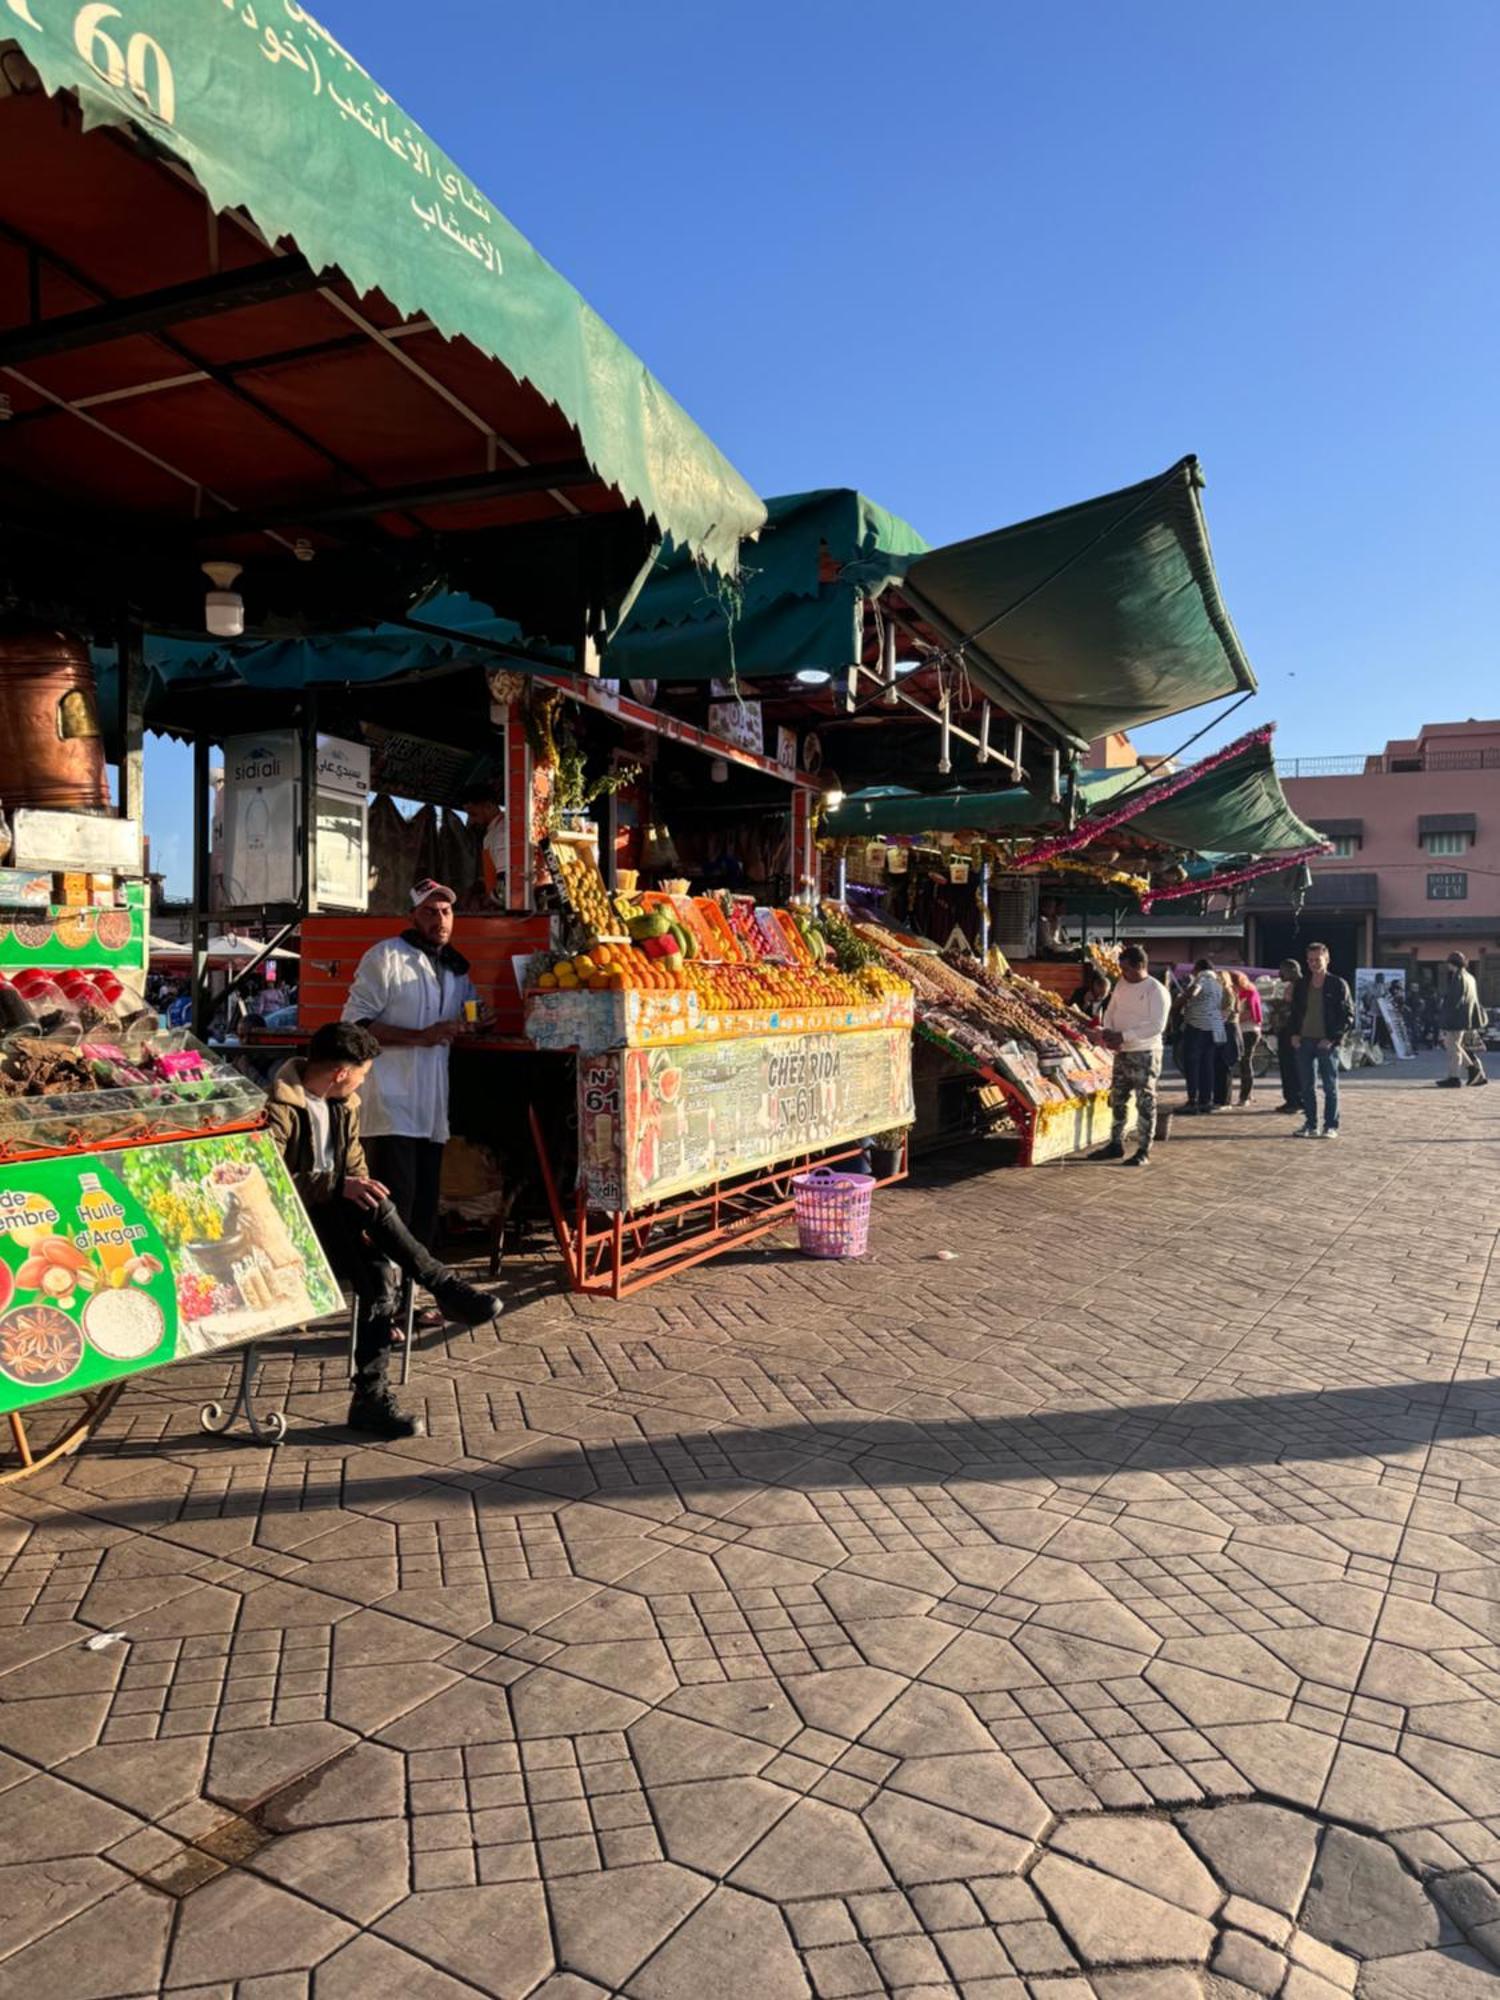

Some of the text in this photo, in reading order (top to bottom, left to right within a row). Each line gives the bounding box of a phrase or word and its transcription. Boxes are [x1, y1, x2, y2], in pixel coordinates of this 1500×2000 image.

[74, 3, 175, 125] 60
[768, 1055, 805, 1087] CHEZ
[810, 1050, 840, 1081] RIDA
[586, 1090, 620, 1113] 61
[0, 1190, 26, 1208] de
[78, 1202, 124, 1222] Huile
[75, 1225, 147, 1249] d'Argan
